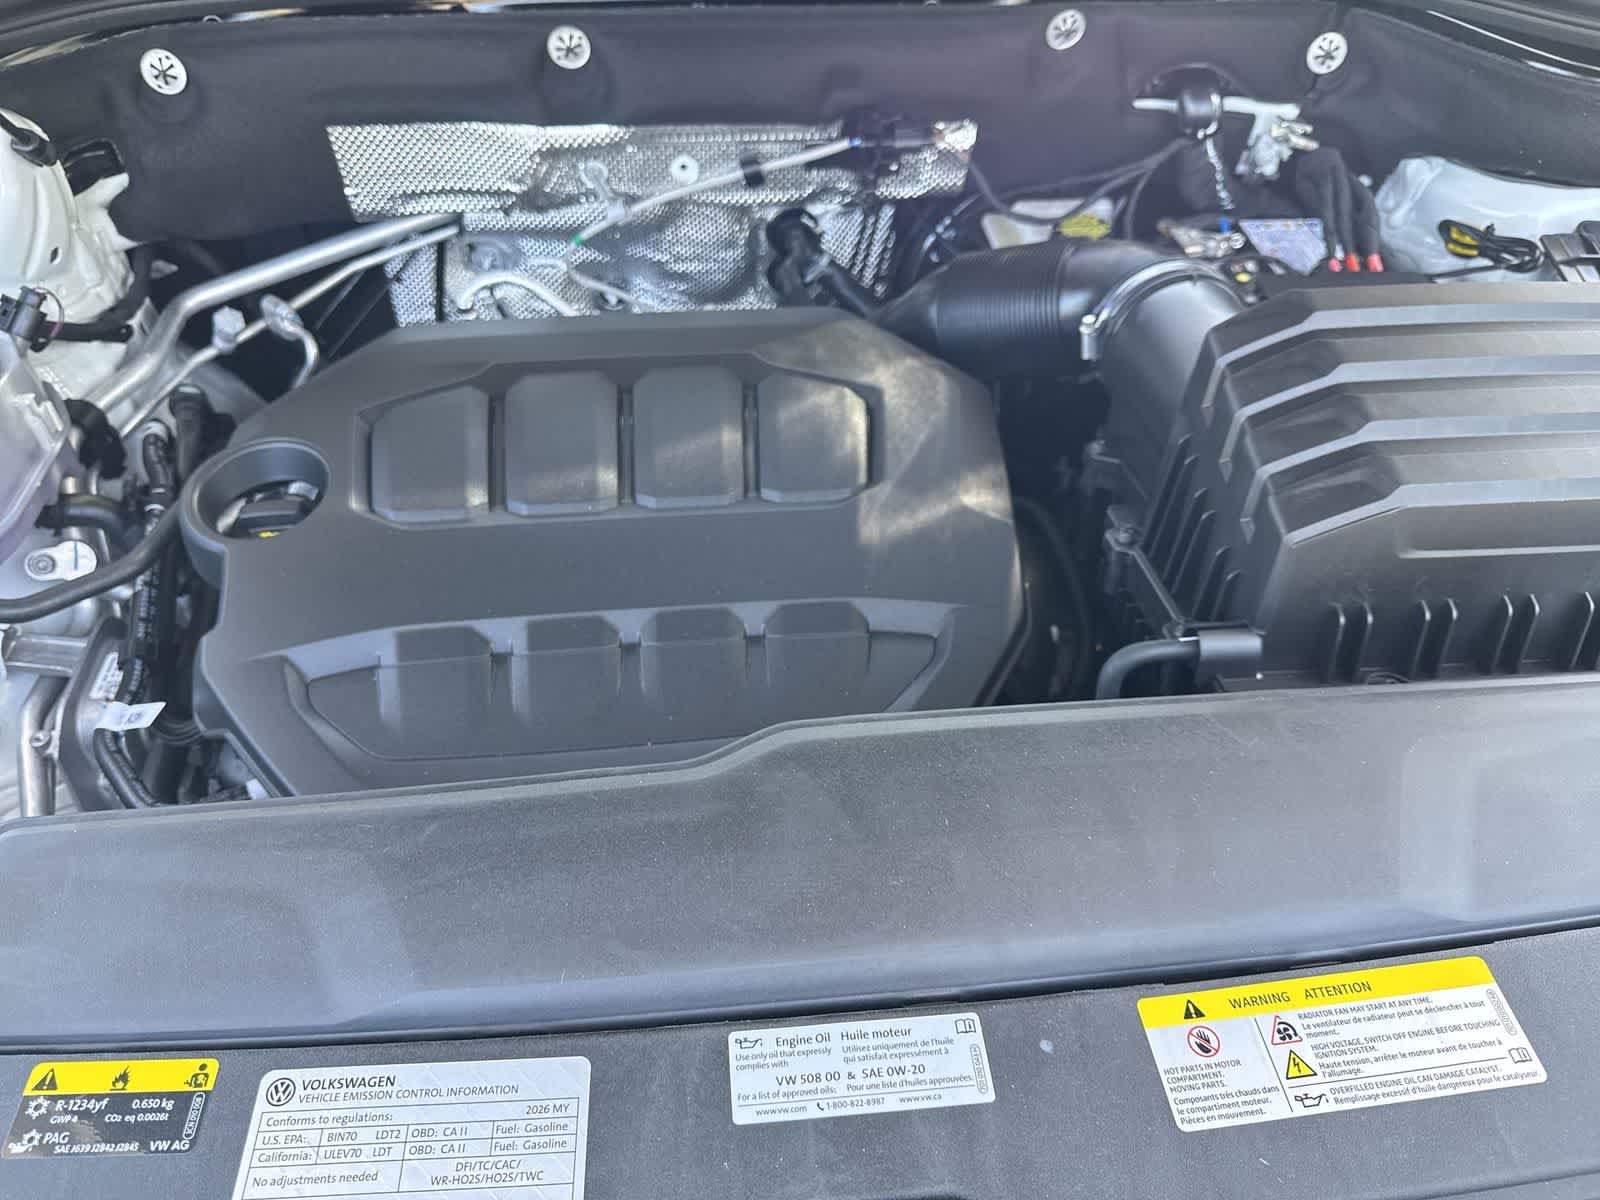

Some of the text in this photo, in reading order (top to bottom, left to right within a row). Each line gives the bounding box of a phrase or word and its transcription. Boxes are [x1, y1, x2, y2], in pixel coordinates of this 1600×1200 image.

[1229, 981, 1373, 1009] WARNING ATTENTION
[1297, 1009, 1334, 1020] RADIATOR
[1334, 1006, 1350, 1015] FAN
[1350, 1005, 1365, 1013] MAY
[1365, 1002, 1387, 1011] START
[1398, 999, 1412, 1007] ANY
[1312, 1018, 1352, 1029] ventilateur
[1352, 1016, 1363, 1024] de
[1363, 1012, 1396, 1022] radiateur
[1397, 1010, 1415, 1019] peut
[1415, 1008, 1424, 1016] se
[1469, 999, 1486, 1008] tout
[775, 1032, 831, 1049] Engine Oil
[840, 1027, 912, 1040] Huile moteur
[1310, 1019, 1501, 1051] HIGH SWITCH OFF ENGINE BEFORE TOUCHING
[841, 1036, 955, 1054] Utilisez uniquement de l'huile
[735, 1046, 832, 1061] Use only oil that expressly
[843, 1054, 856, 1064] qui
[857, 1051, 887, 1062] satisfait
[1314, 1049, 1347, 1060] IGNITION
[1319, 1060, 1342, 1070] Haute
[1399, 1051, 1408, 1059] le
[1408, 1047, 1436, 1058] moteur
[1436, 1044, 1458, 1054] avant
[1458, 1042, 1468, 1051] de
[1468, 1039, 1497, 1050] toucher
[735, 1060, 789, 1072] complies with
[1163, 1059, 1241, 1076] HOT PARTS IN MOTOR
[775, 1063, 926, 1086] VW 508 00 & SAE 0W-20
[1329, 1082, 1375, 1095] OVERFILLED
[1375, 1078, 1404, 1089] ENGINE
[1404, 1076, 1418, 1085] OIL
[1417, 1075, 1433, 1084] CAN
[1433, 1070, 1466, 1081] DAMAGE
[302, 1075, 396, 1091] VOLKSWAGEN
[846, 1077, 928, 1092] Pour une liste d'huiles
[1169, 1083, 1201, 1094] MOVING
[1381, 1088, 1411, 1099] excessif
[1412, 1084, 1436, 1095] d'huile
[1437, 1079, 1475, 1091] dangereux
[1476, 1077, 1494, 1086] pour
[1494, 1075, 1502, 1083] le
[299, 1084, 519, 1104] VEHICLE EMISSION CONTROL INFORMATION
[737, 1092, 751, 1101] For
[758, 1091, 770, 1100] list
[771, 1089, 780, 1099] of
[781, 1087, 819, 1099] approved
[1173, 1093, 1220, 1106] Composants
[1235, 1087, 1262, 1098] chauds
[1262, 1084, 1280, 1094] dans
[55, 1097, 175, 1114] R-1234yf 0.650 kg
[526, 1103, 570, 1115] 2026 MY
[755, 1093, 942, 1116] www.vw.com 1-800-822-8987 www.vw.ca
[1176, 1099, 1241, 1115] le compartiment
[124, 1114, 136, 1125] eq
[137, 1112, 170, 1122] 0.0026t
[266, 1111, 393, 1127] Conforms to regulations:
[1206, 1113, 1217, 1121] en
[42, 1131, 71, 1145] PAG
[262, 1135, 281, 1145] U.S.
[283, 1134, 307, 1145] EPA:
[327, 1131, 358, 1142] BIN70
[375, 1129, 401, 1140] LDT2
[411, 1128, 437, 1138] OBD:
[496, 1124, 519, 1134] Fuel:
[524, 1121, 568, 1133] Gasoline
[54, 1144, 71, 1154] SAE
[150, 1139, 190, 1151] VW AG
[257, 1150, 312, 1163] California:
[324, 1148, 362, 1160] ULEV70
[372, 1146, 392, 1157] LDT
[408, 1145, 435, 1155] OBD:
[494, 1141, 518, 1151] Fuel:
[522, 1138, 567, 1150] Gasoline
[455, 1159, 522, 1172] DFI/TC/CAC/
[252, 1170, 378, 1188] No adjustments needed
[430, 1170, 544, 1186] WR-HO2S/HO2S/TWC
